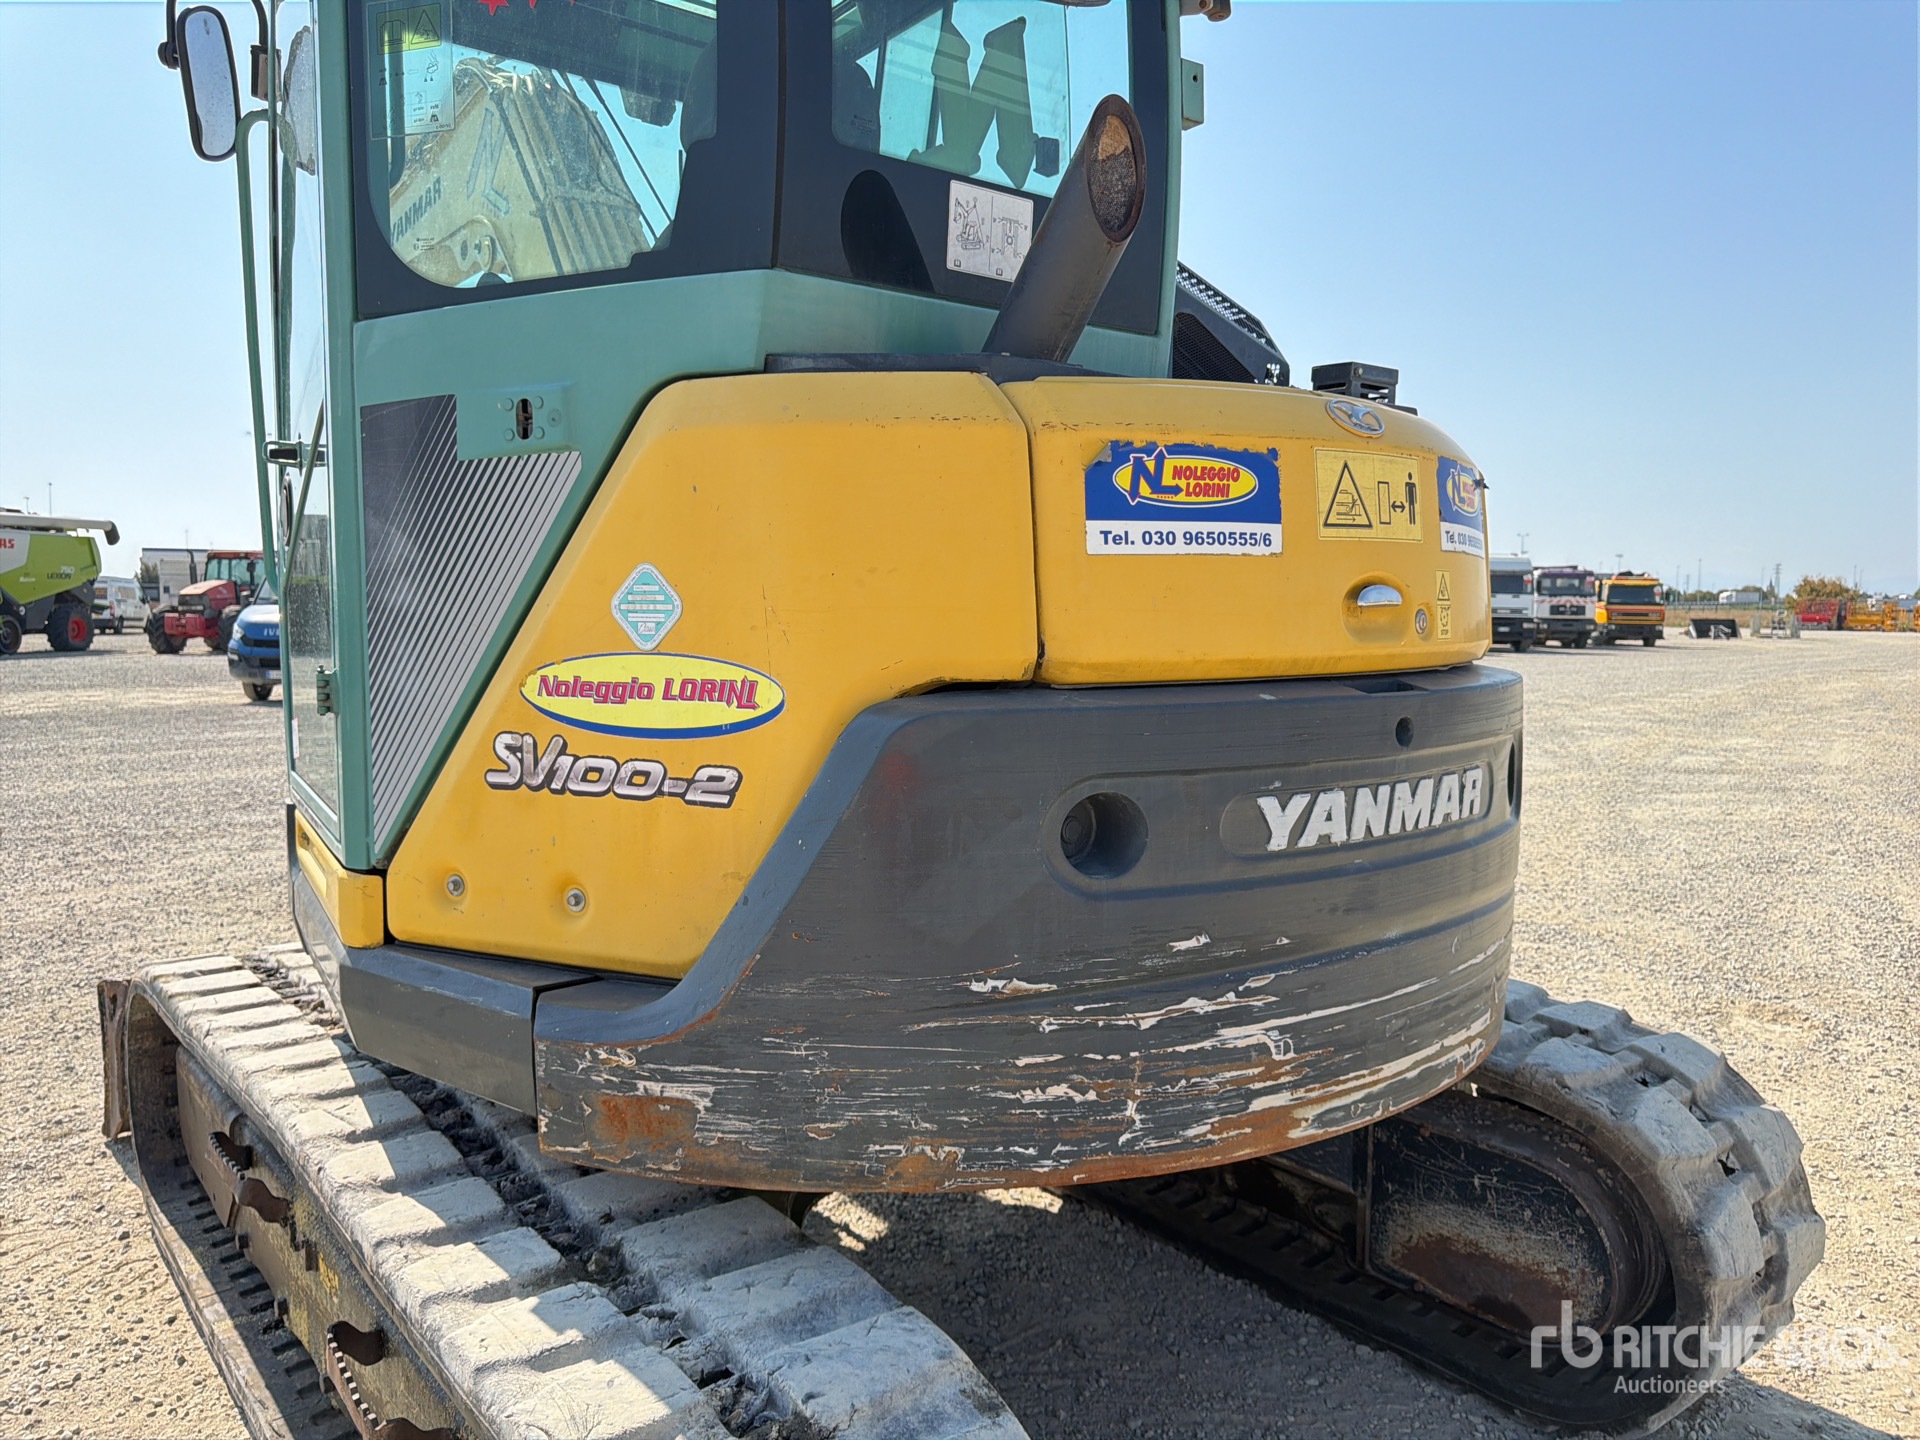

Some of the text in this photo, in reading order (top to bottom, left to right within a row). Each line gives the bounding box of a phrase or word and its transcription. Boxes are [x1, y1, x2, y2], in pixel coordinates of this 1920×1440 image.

[1172, 465, 1241, 482] NOLEGGIO
[1185, 482, 1231, 498] LORINI
[1100, 530, 1272, 548] Tel. 030 9650555/6
[47, 572, 72, 580] LEXION
[537, 675, 761, 711] Noleggio LORINI
[484, 731, 743, 809] SV100-2
[1256, 765, 1483, 852] YANMAR
